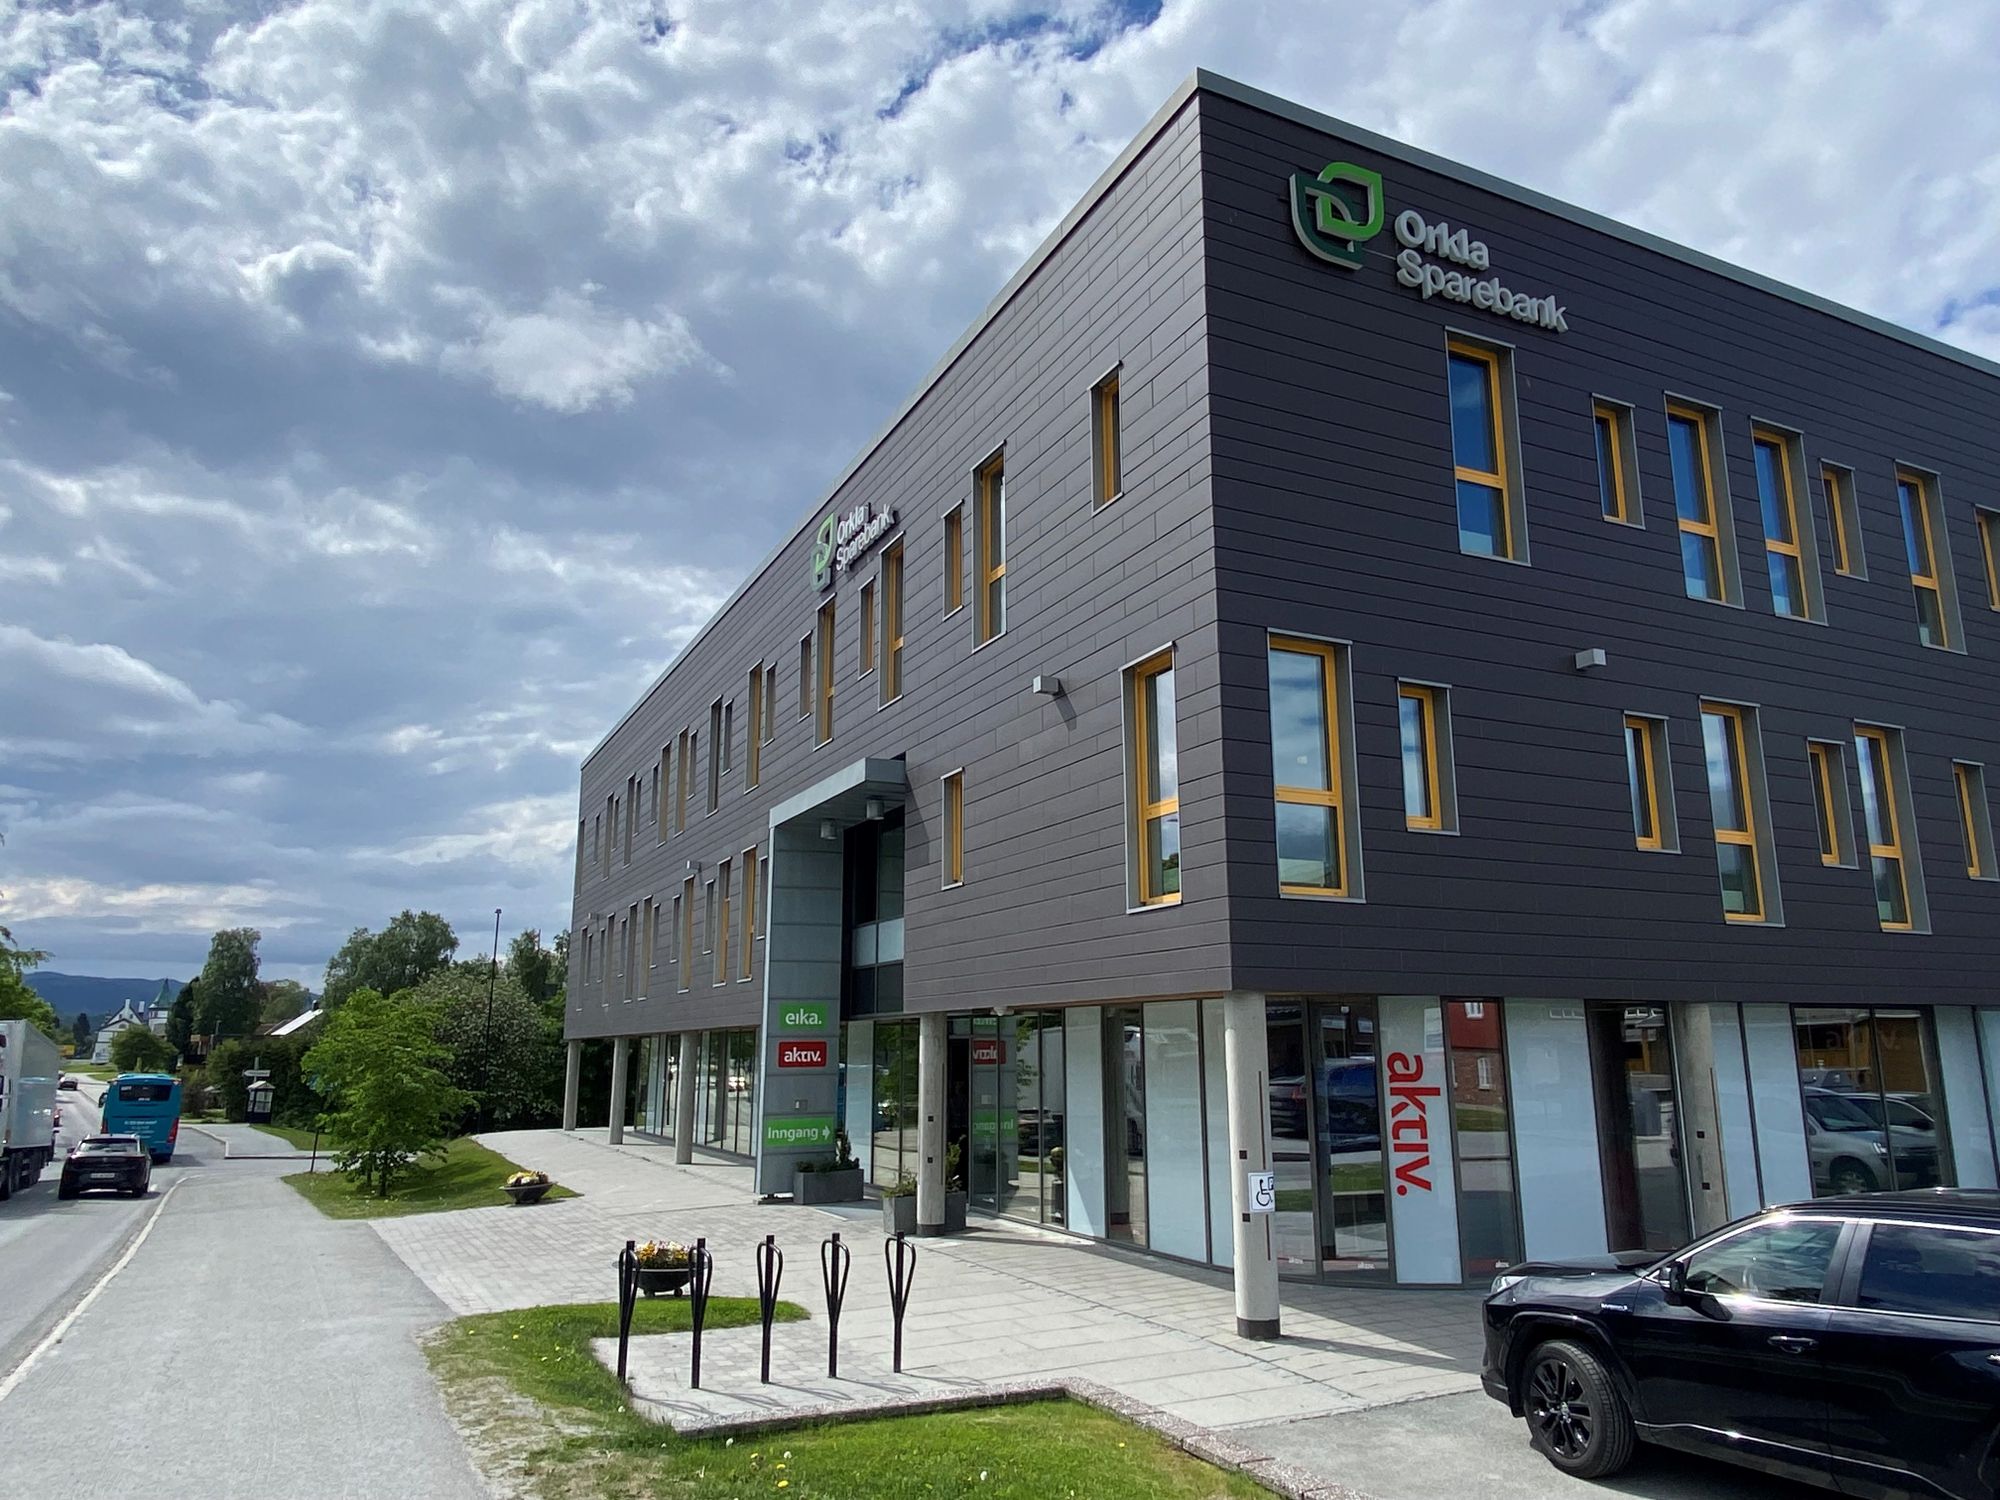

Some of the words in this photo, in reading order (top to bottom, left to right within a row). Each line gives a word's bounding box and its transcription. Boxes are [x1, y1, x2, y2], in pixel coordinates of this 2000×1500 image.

[1394, 209, 1490, 271] Orkla
[1396, 249, 1569, 333] Sparebank
[836, 503, 895, 573] Sparebank
[837, 505, 868, 545] Orkla
[767, 1127, 819, 1142] Inngang
